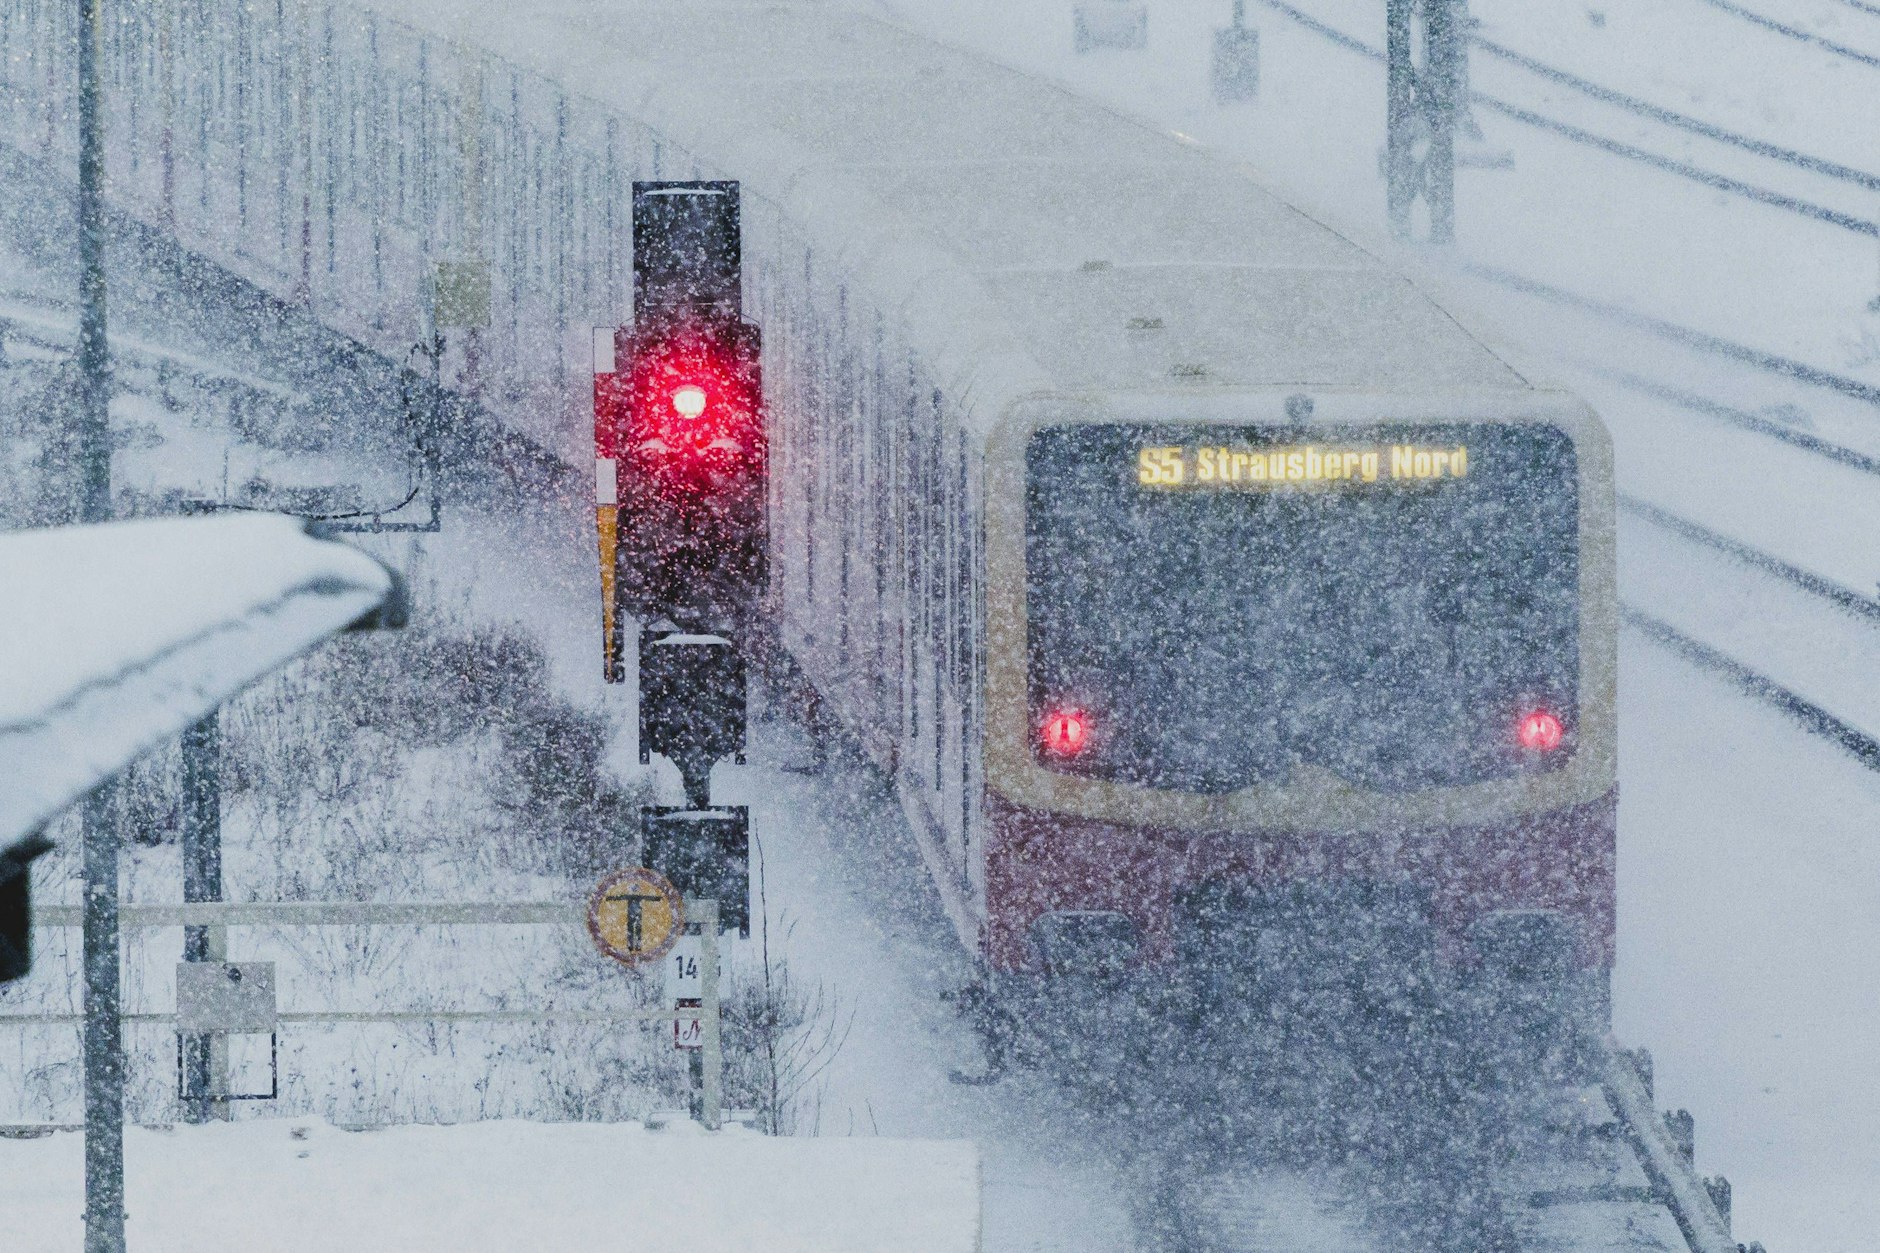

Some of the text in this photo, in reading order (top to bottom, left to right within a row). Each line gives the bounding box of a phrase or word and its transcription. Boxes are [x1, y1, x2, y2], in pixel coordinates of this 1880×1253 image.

[1140, 446, 1467, 485] S5 Strausberg Nord
[605, 894, 662, 952] T
